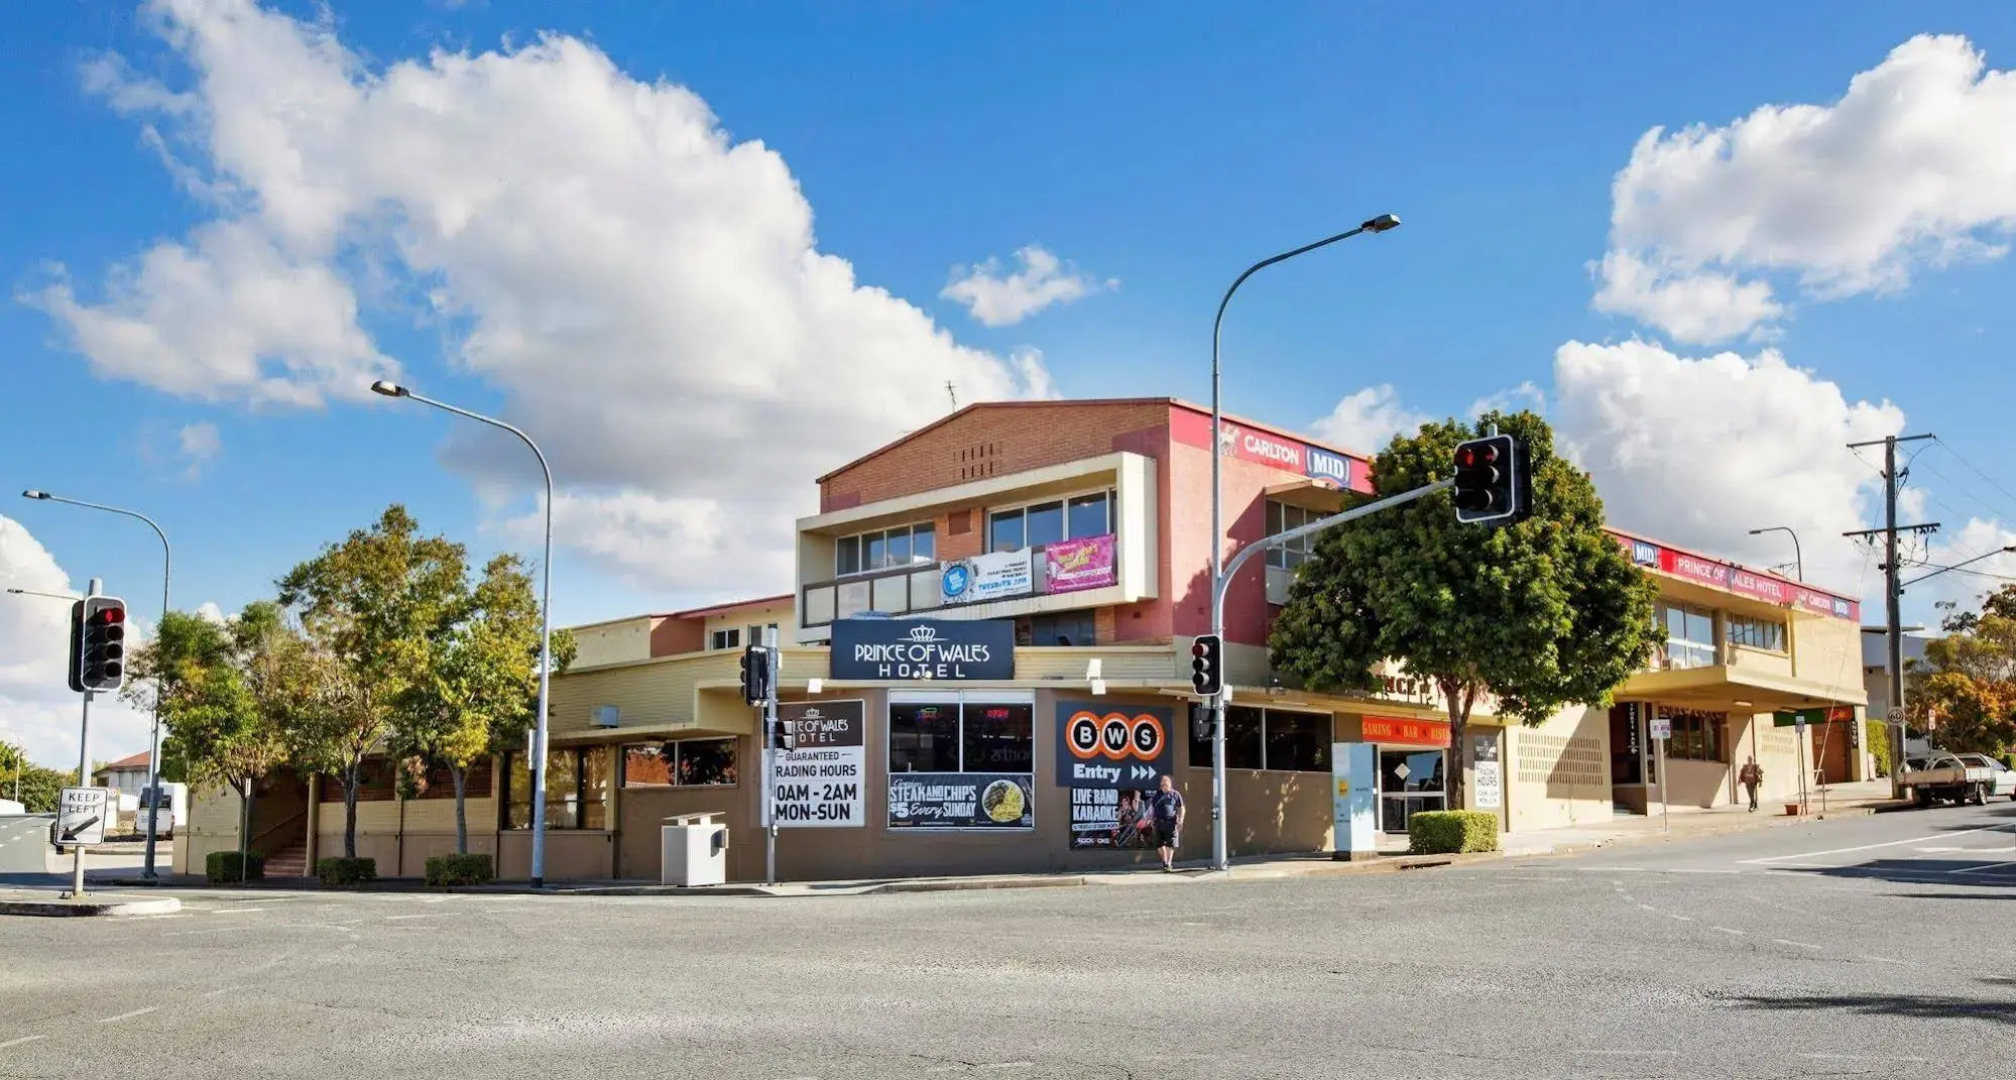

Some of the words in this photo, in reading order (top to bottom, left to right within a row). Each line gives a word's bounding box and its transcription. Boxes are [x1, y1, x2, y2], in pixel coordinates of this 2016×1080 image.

[1244, 435, 1299, 465] CARLTON
[1313, 452, 1345, 479] MID
[1635, 544, 1655, 563] MID
[1677, 558, 1711, 578] PRINCE
[1713, 568, 1725, 581] OF
[1756, 580, 1782, 598] HOTEL
[855, 644, 905, 662] PRINCE
[908, 644, 936, 662] OF
[938, 644, 990, 662] WALES
[879, 664, 966, 678] HOTEL
[820, 719, 849, 731] WALES
[800, 733, 836, 743] OTEL
[1080, 726, 1151, 745] BWS
[785, 751, 839, 761] GUARANTEED
[775, 765, 817, 777] RADING
[820, 764, 857, 777] HOURS
[1073, 763, 1122, 783] Entry
[68, 792, 100, 802] KEEP
[777, 784, 809, 801] 0AM
[823, 784, 857, 801] 2AM
[890, 786, 926, 801] STEAK
[926, 785, 944, 797] AND
[944, 785, 977, 801] CHIPS
[1072, 789, 1092, 804] LIVE
[1093, 789, 1118, 804] BAND
[68, 803, 98, 813] LEFT
[775, 803, 851, 820] MON-SUN
[890, 802, 909, 818] $5
[909, 802, 944, 819] Every
[943, 802, 977, 817] SUNDAY
[1072, 805, 1118, 821] KARAOKE
